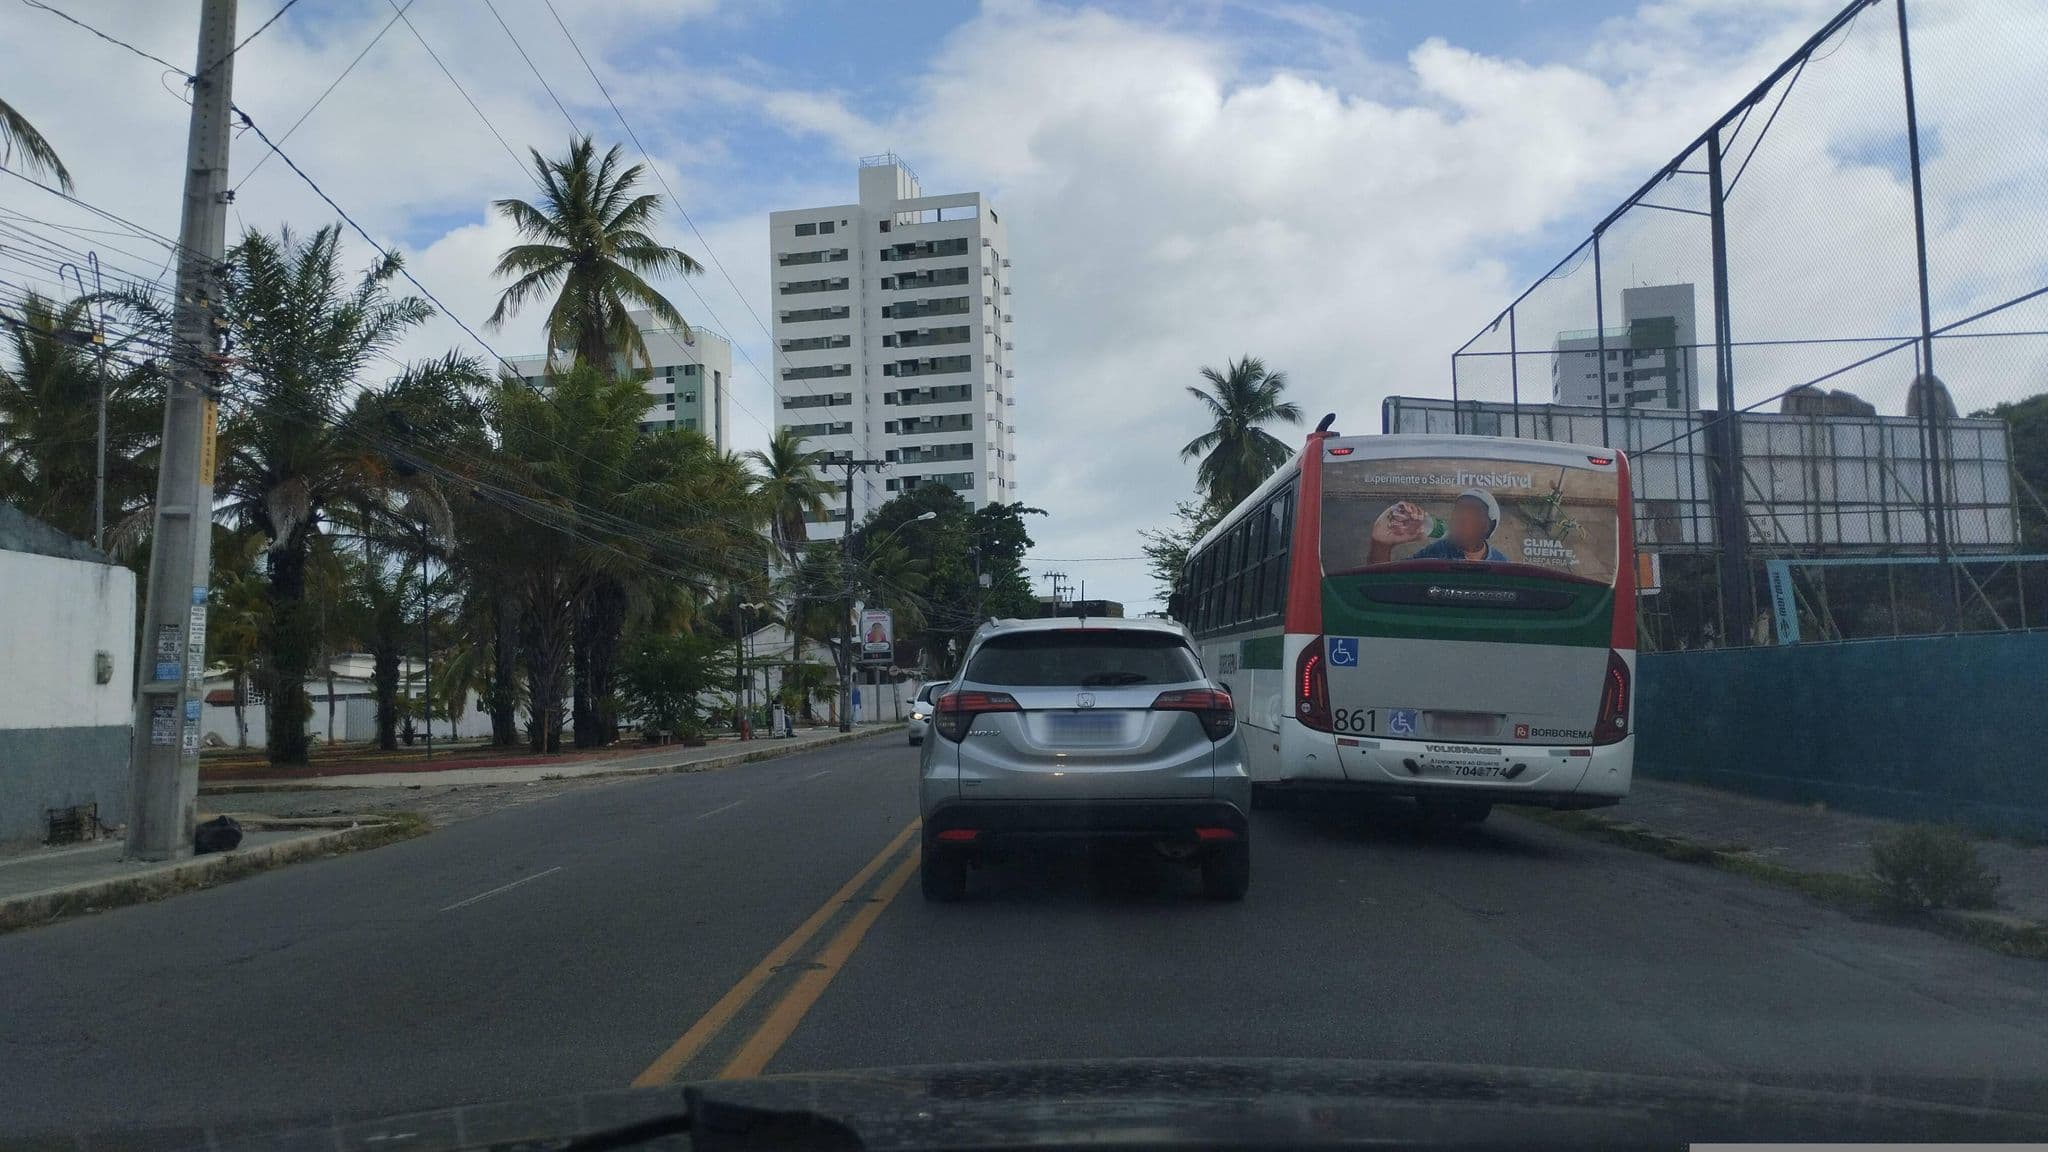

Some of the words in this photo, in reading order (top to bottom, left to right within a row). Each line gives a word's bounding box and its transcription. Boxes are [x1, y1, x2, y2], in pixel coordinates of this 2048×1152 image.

[1364, 472, 1420, 486] Experimente
[1429, 474, 1456, 486] Sabor
[1523, 538, 1563, 549] CLIMA
[1334, 708, 1376, 732] 861
[1531, 727, 1593, 739] BORBOREMA
[1425, 744, 1502, 755] VOLKSWAGEN
